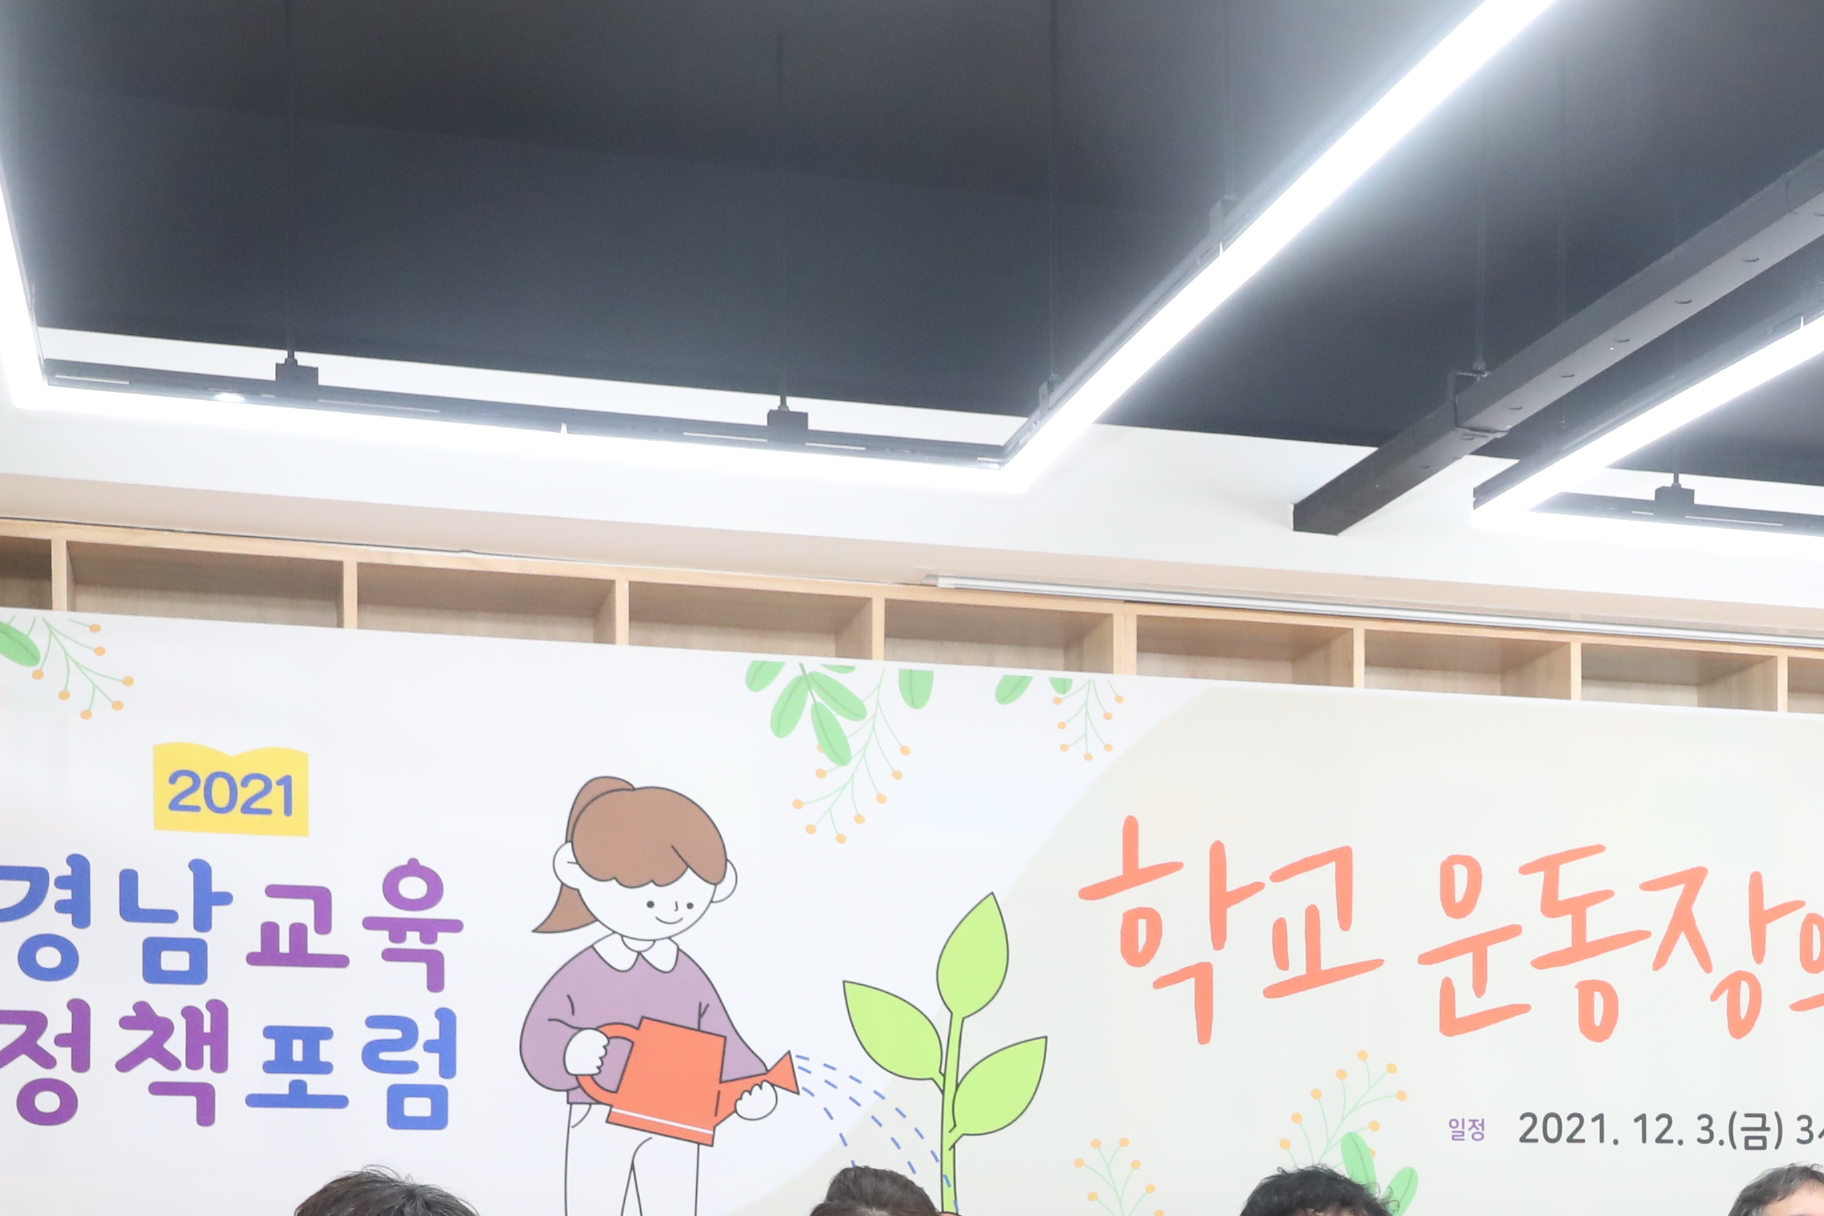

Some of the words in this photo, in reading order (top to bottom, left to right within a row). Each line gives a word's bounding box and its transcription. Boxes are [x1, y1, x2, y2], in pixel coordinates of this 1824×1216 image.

[167, 768, 294, 817] 2021
[0, 854, 464, 993] 경남교육
[1078, 815, 1385, 1045] 학교
[0, 999, 457, 1130] 정책포럼
[1448, 1118, 1486, 1142] 일정
[1518, 1111, 1620, 1146] 2021.
[1633, 1112, 1684, 1146] 12.
[1696, 1110, 1783, 1151] 3.(금)
